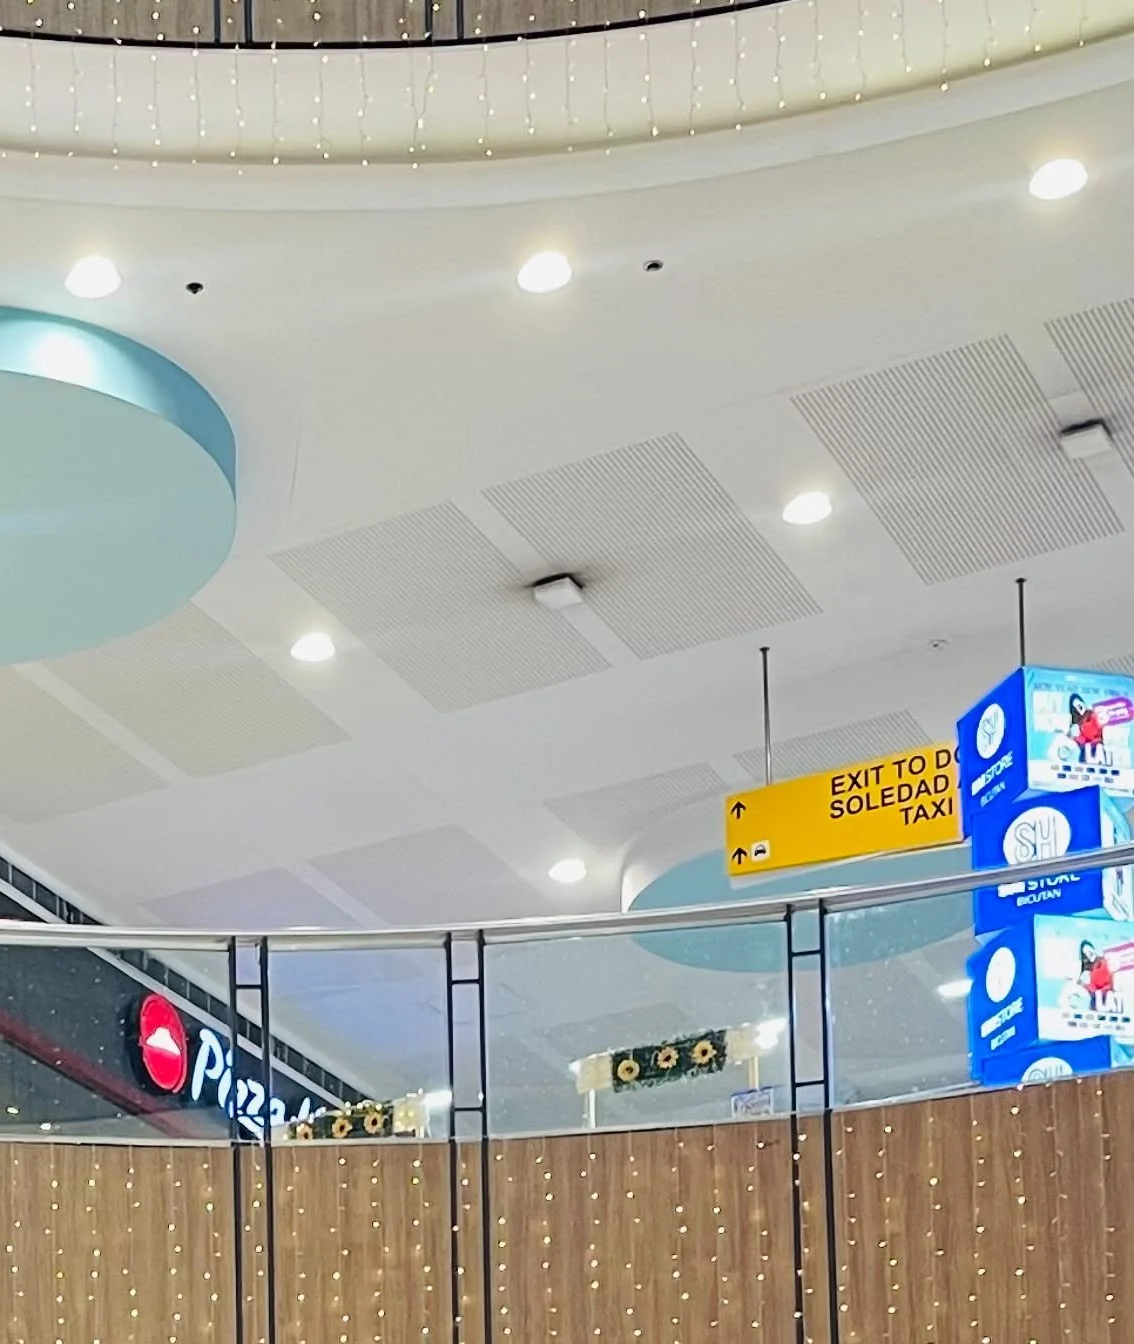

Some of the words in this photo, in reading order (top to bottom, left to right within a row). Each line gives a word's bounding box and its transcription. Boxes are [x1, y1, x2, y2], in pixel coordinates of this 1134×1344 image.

[831, 764, 884, 796] EXIT
[892, 753, 928, 782] TO
[829, 774, 951, 820] SOLEDAD
[899, 798, 954, 827] TAXI
